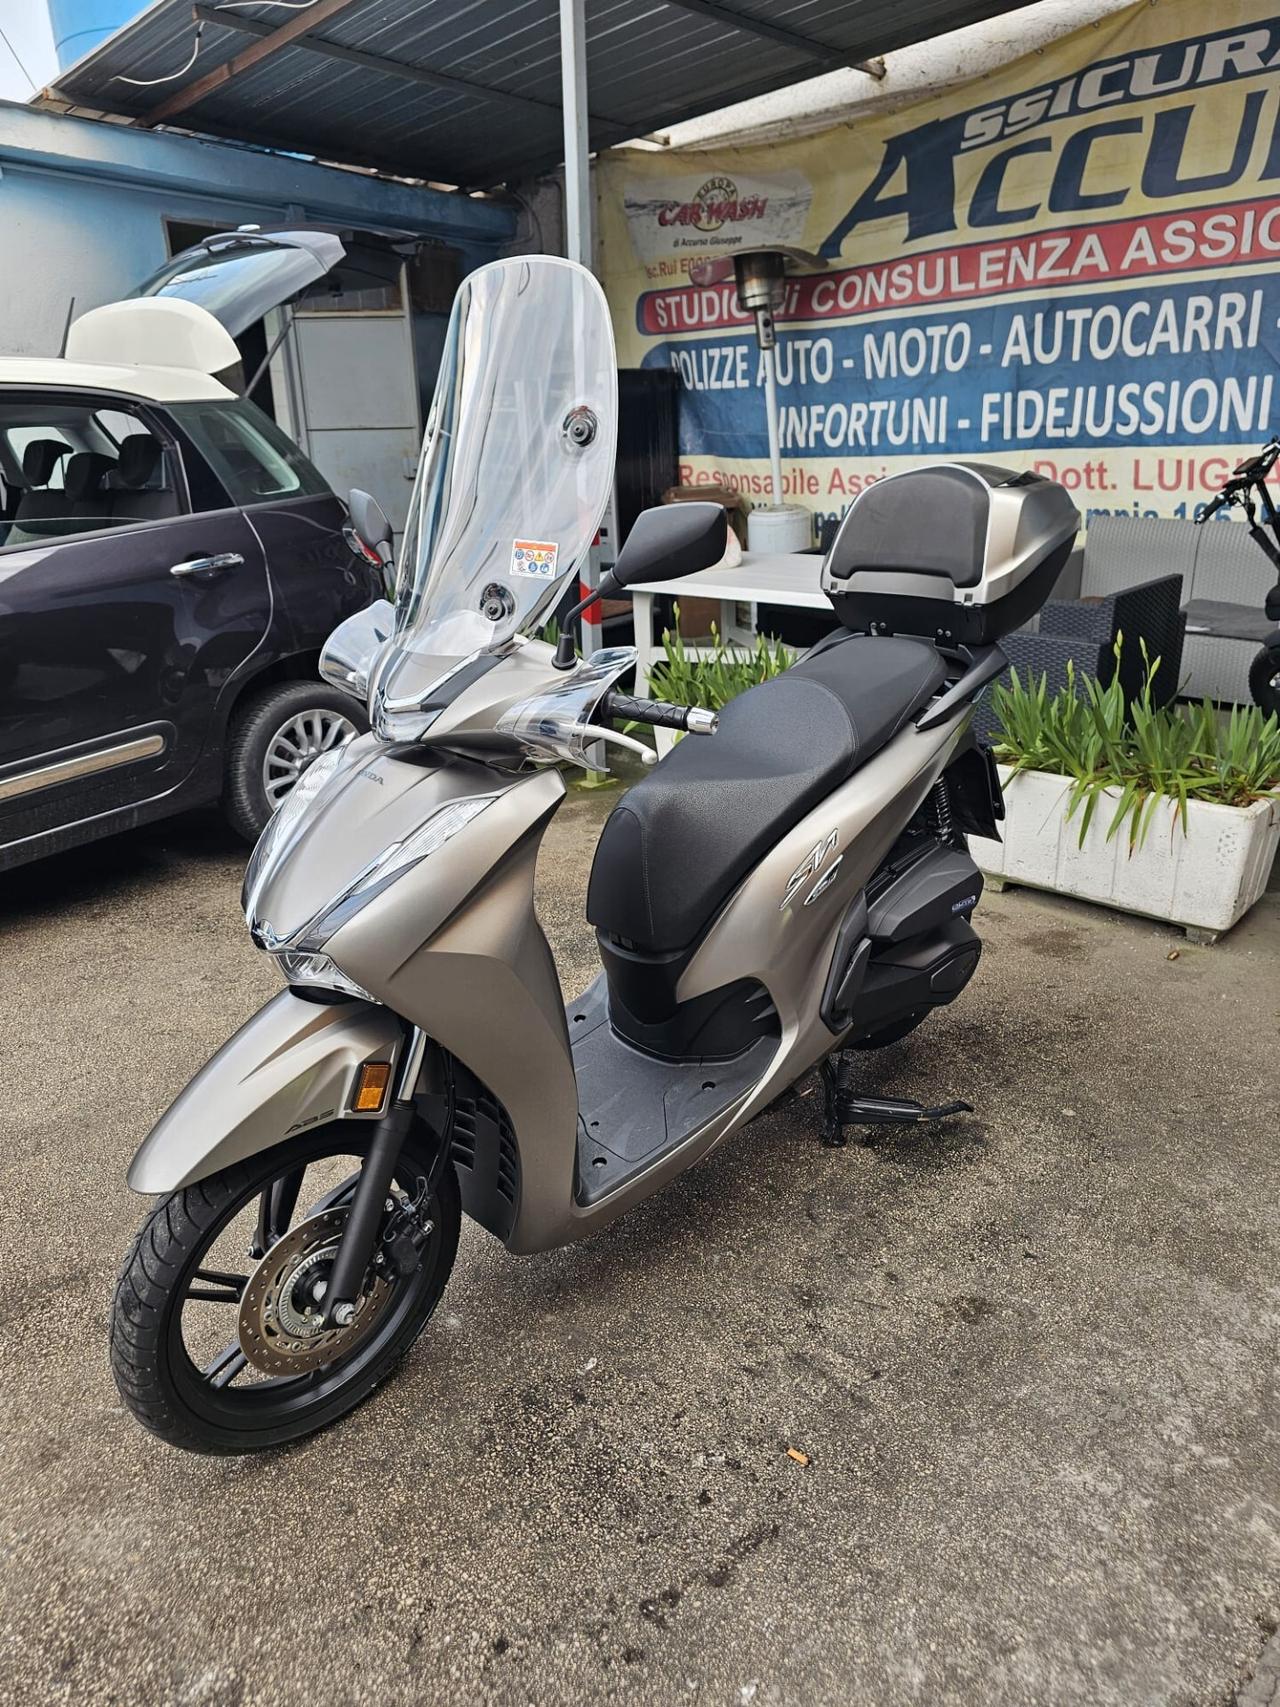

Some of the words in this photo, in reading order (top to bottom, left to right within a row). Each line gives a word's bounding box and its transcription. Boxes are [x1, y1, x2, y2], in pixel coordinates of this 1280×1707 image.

[658, 201, 702, 227] CAR
[706, 197, 768, 224] WASH
[709, 235, 743, 247] Giuseppe
[811, 234, 1110, 313] CONSULENZA
[757, 337, 834, 388] AUTO
[863, 322, 971, 380] MOTO
[1001, 289, 1263, 368] AUTOCARRI
[779, 396, 948, 449] INFORTUNI
[981, 375, 1274, 442] FIDEJUSSIONI
[1034, 460, 1117, 491] Dott.
